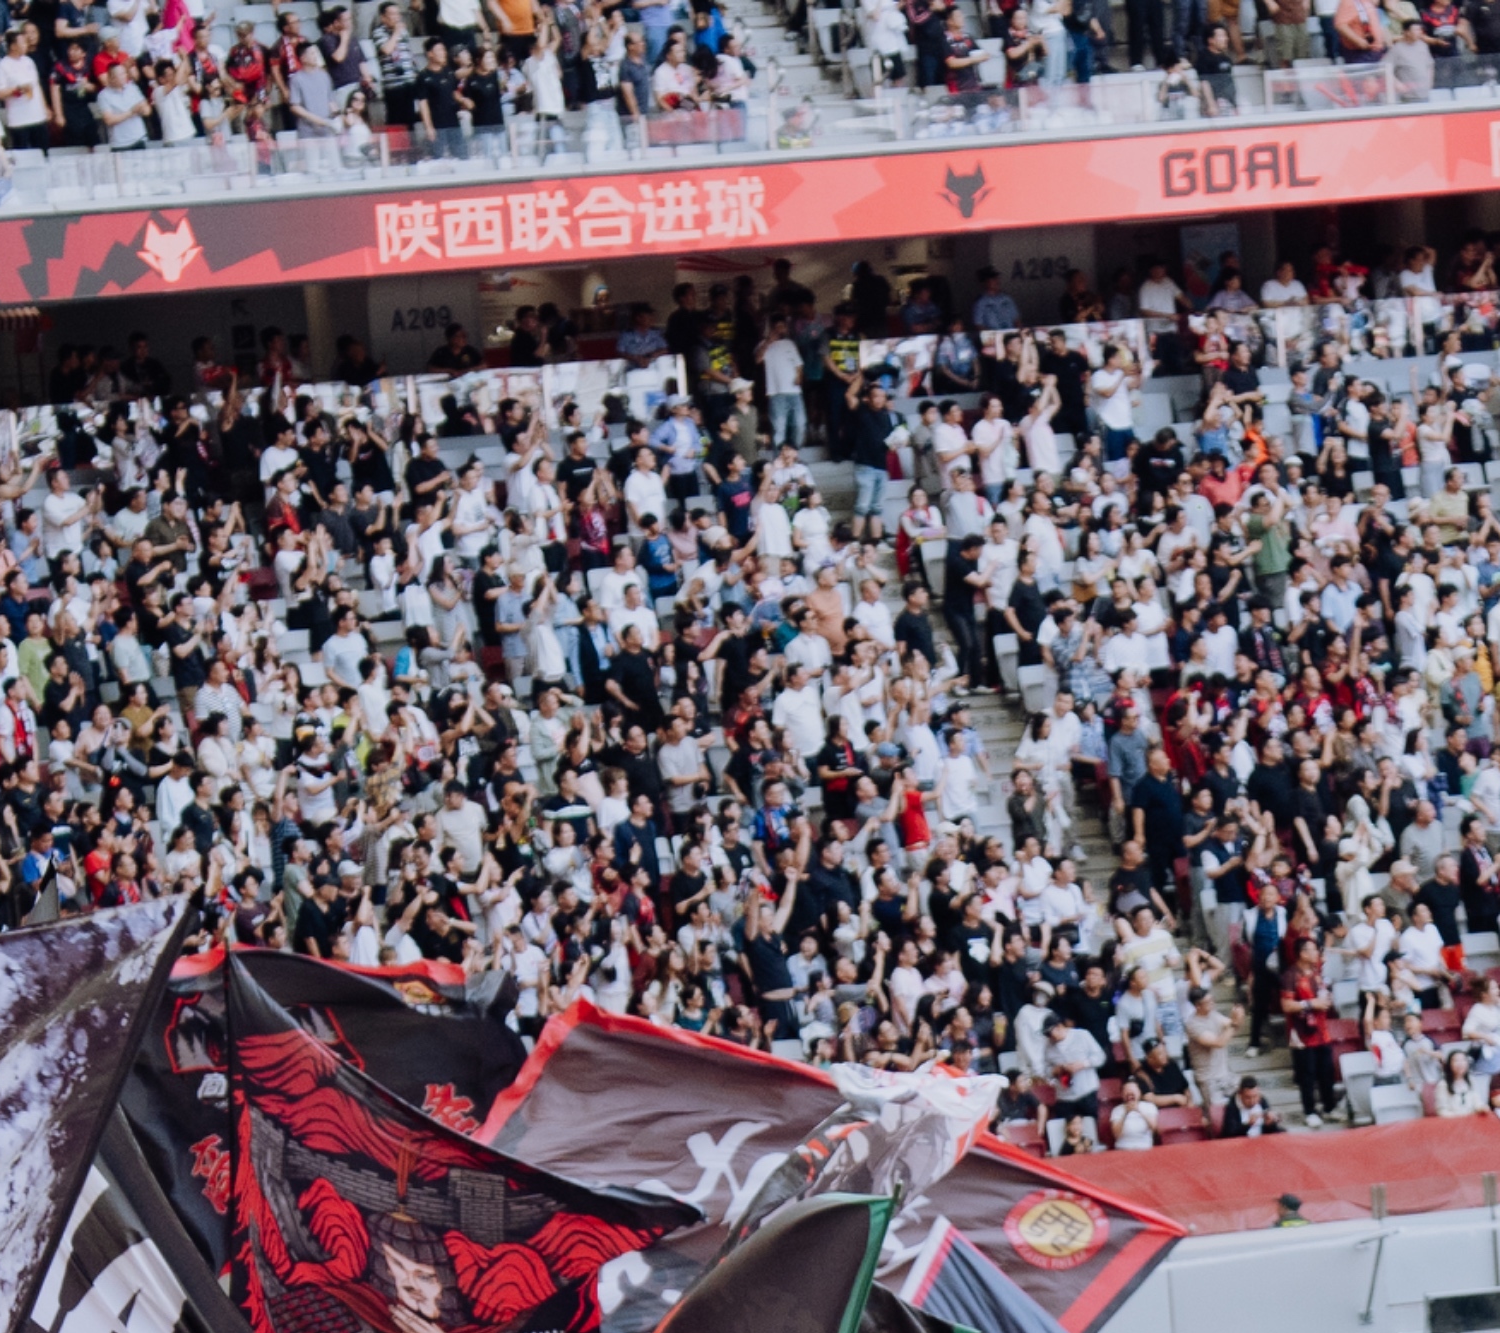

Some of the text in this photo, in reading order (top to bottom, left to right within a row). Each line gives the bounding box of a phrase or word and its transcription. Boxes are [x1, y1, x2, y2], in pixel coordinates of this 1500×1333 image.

[1160, 137, 1322, 201] GOAL
[374, 176, 770, 265] 陕西联合进球
